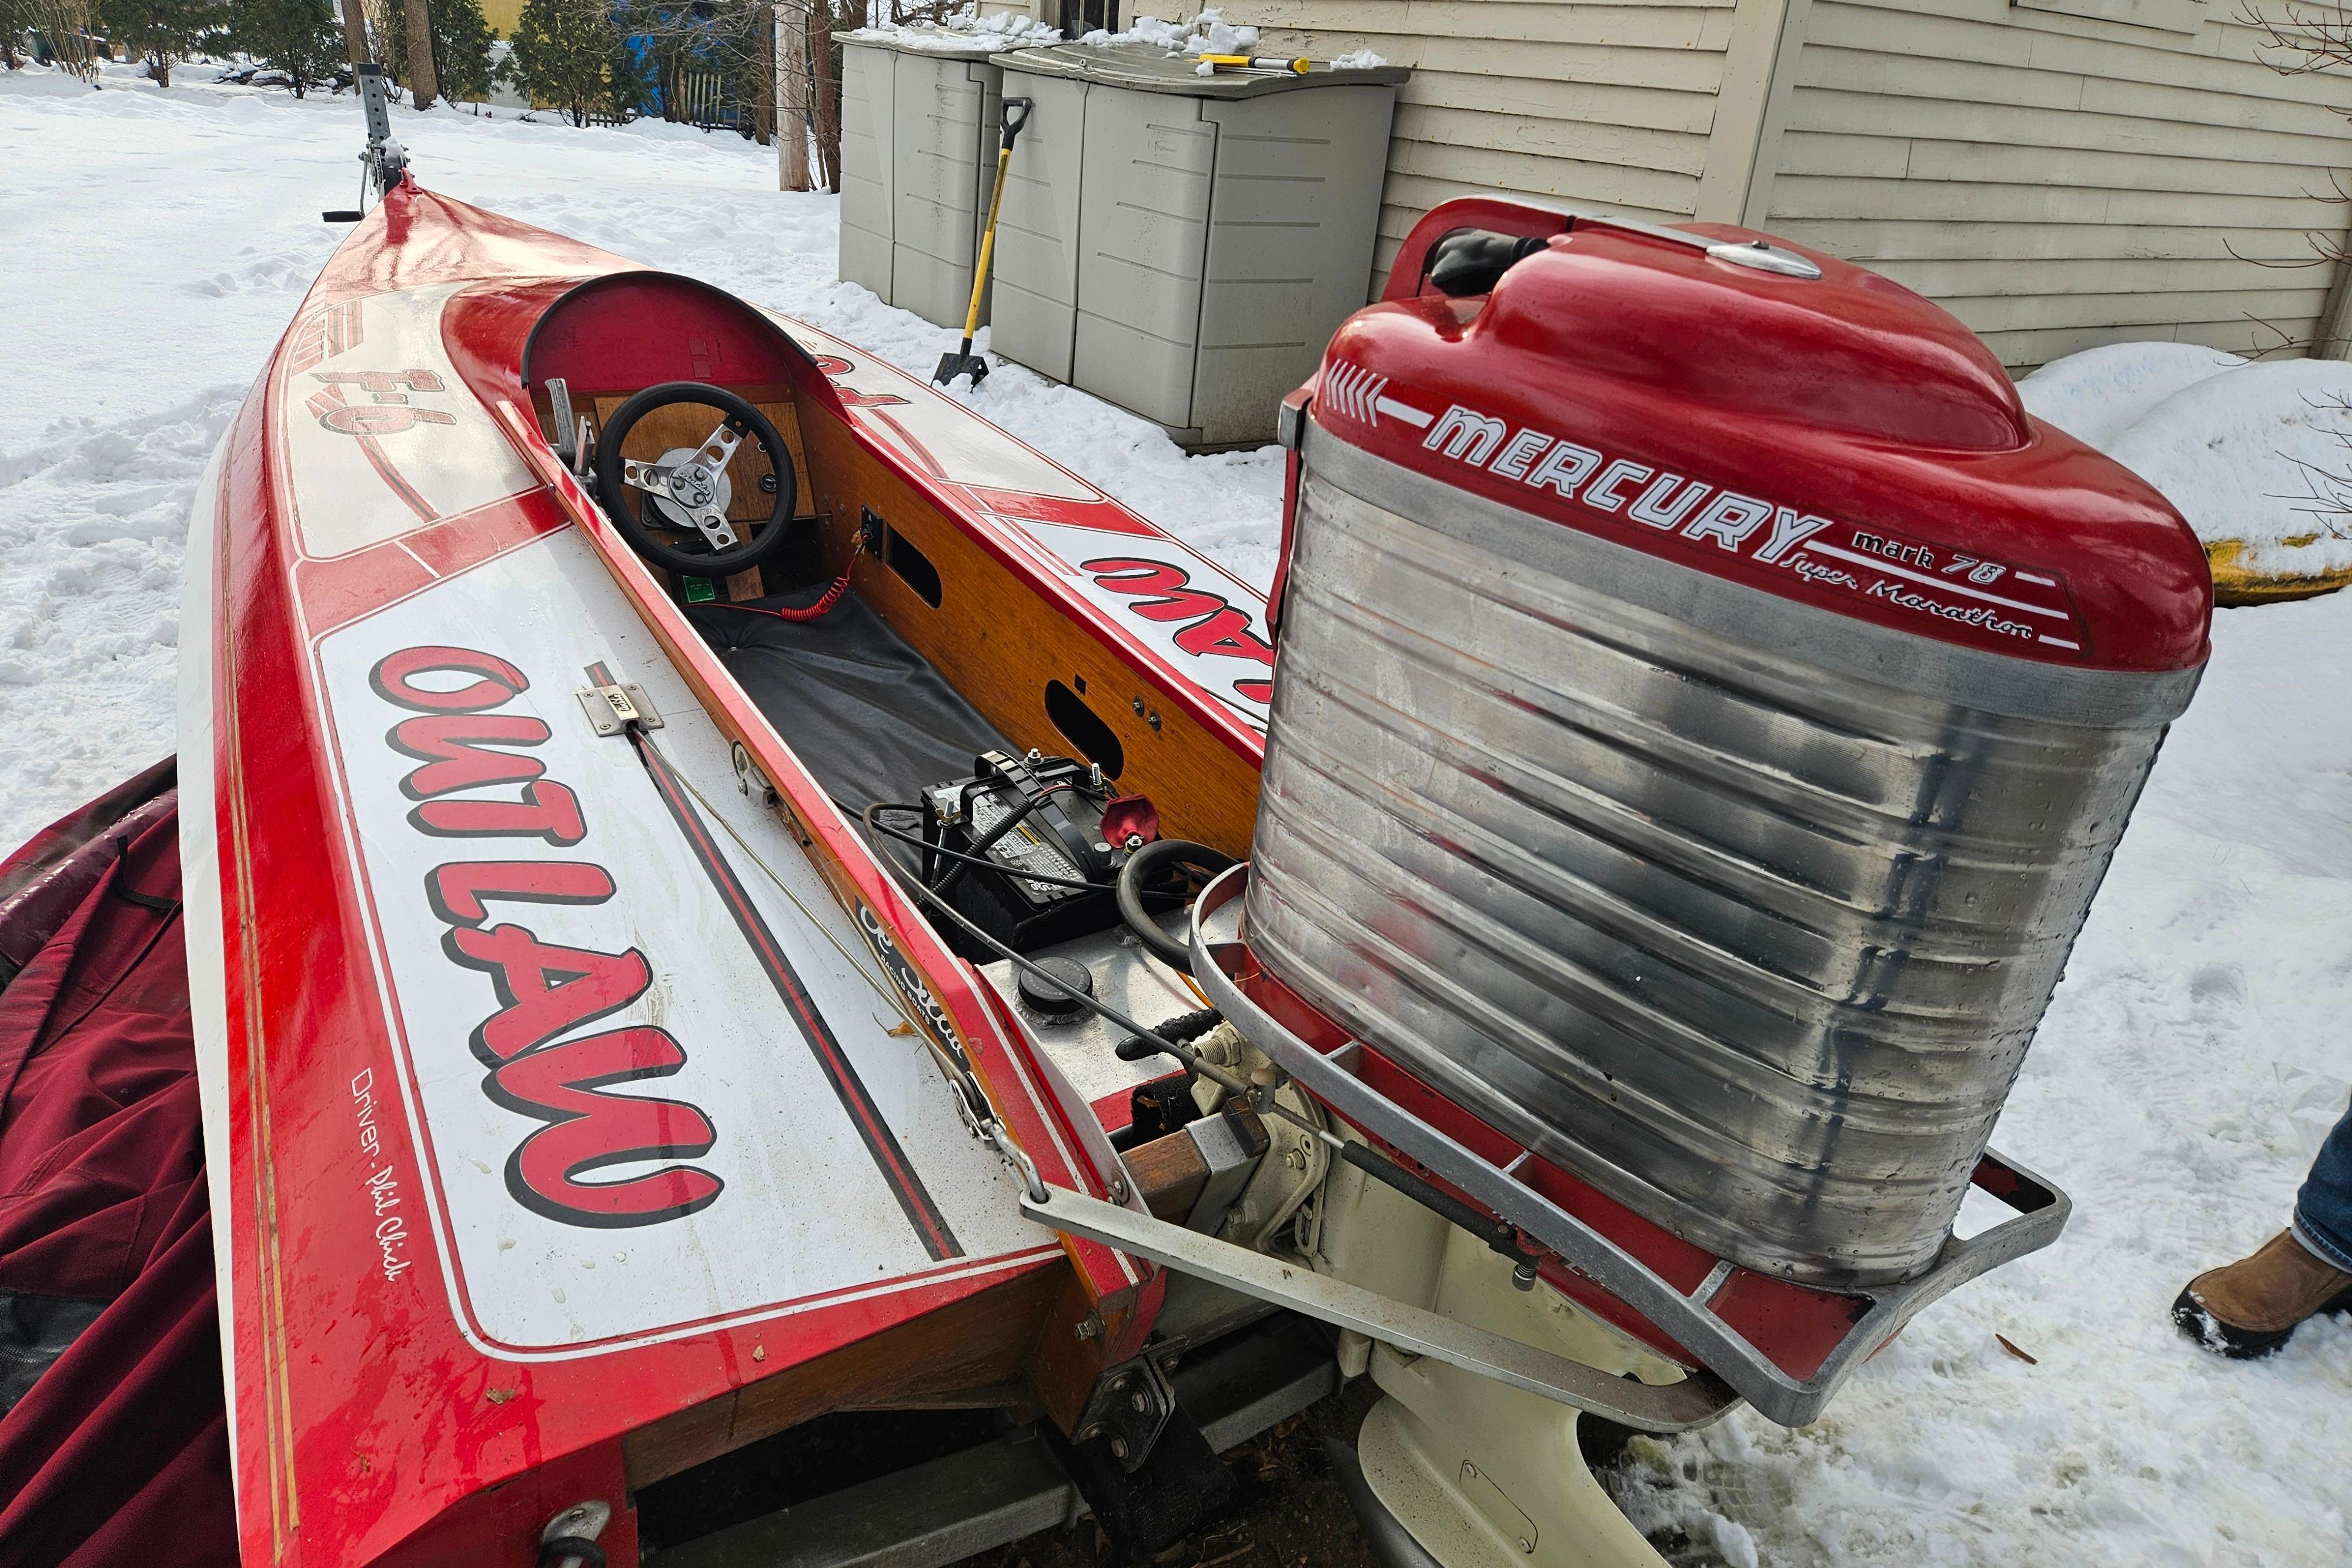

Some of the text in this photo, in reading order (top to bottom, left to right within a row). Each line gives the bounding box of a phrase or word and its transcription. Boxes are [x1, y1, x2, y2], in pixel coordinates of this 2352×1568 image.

[1422, 404, 1833, 564] MERCURY
[1779, 552, 2032, 640] Super Marathon
[1852, 531, 2006, 585] mark 78
[369, 646, 724, 1229] OUTLAW
[881, 954, 930, 1025] RACING BOATS
[351, 1066, 380, 1160] Driver
